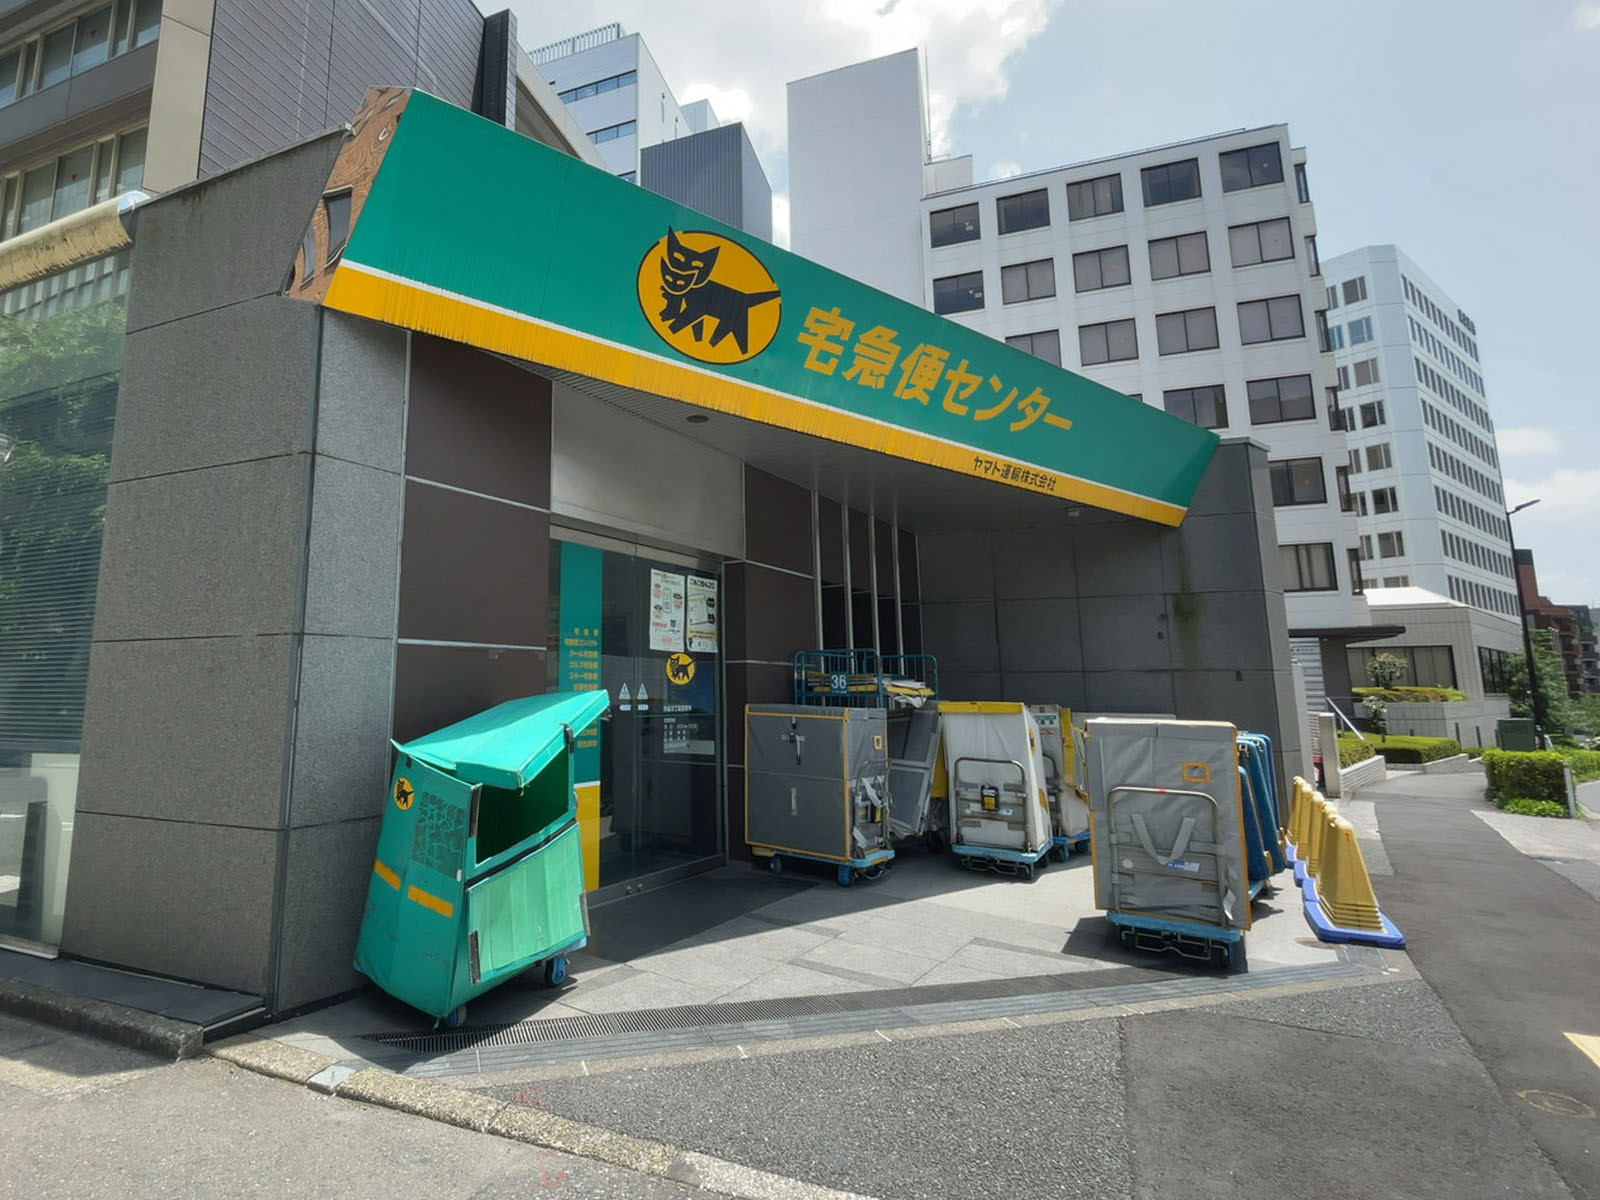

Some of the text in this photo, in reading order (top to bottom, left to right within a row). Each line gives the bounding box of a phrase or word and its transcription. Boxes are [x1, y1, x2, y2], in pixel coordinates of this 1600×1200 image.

[797, 306, 1072, 432] 宅急便センター
[973, 456, 1056, 491] ヤマト運輸株式会社
[831, 674, 847, 689] 36
